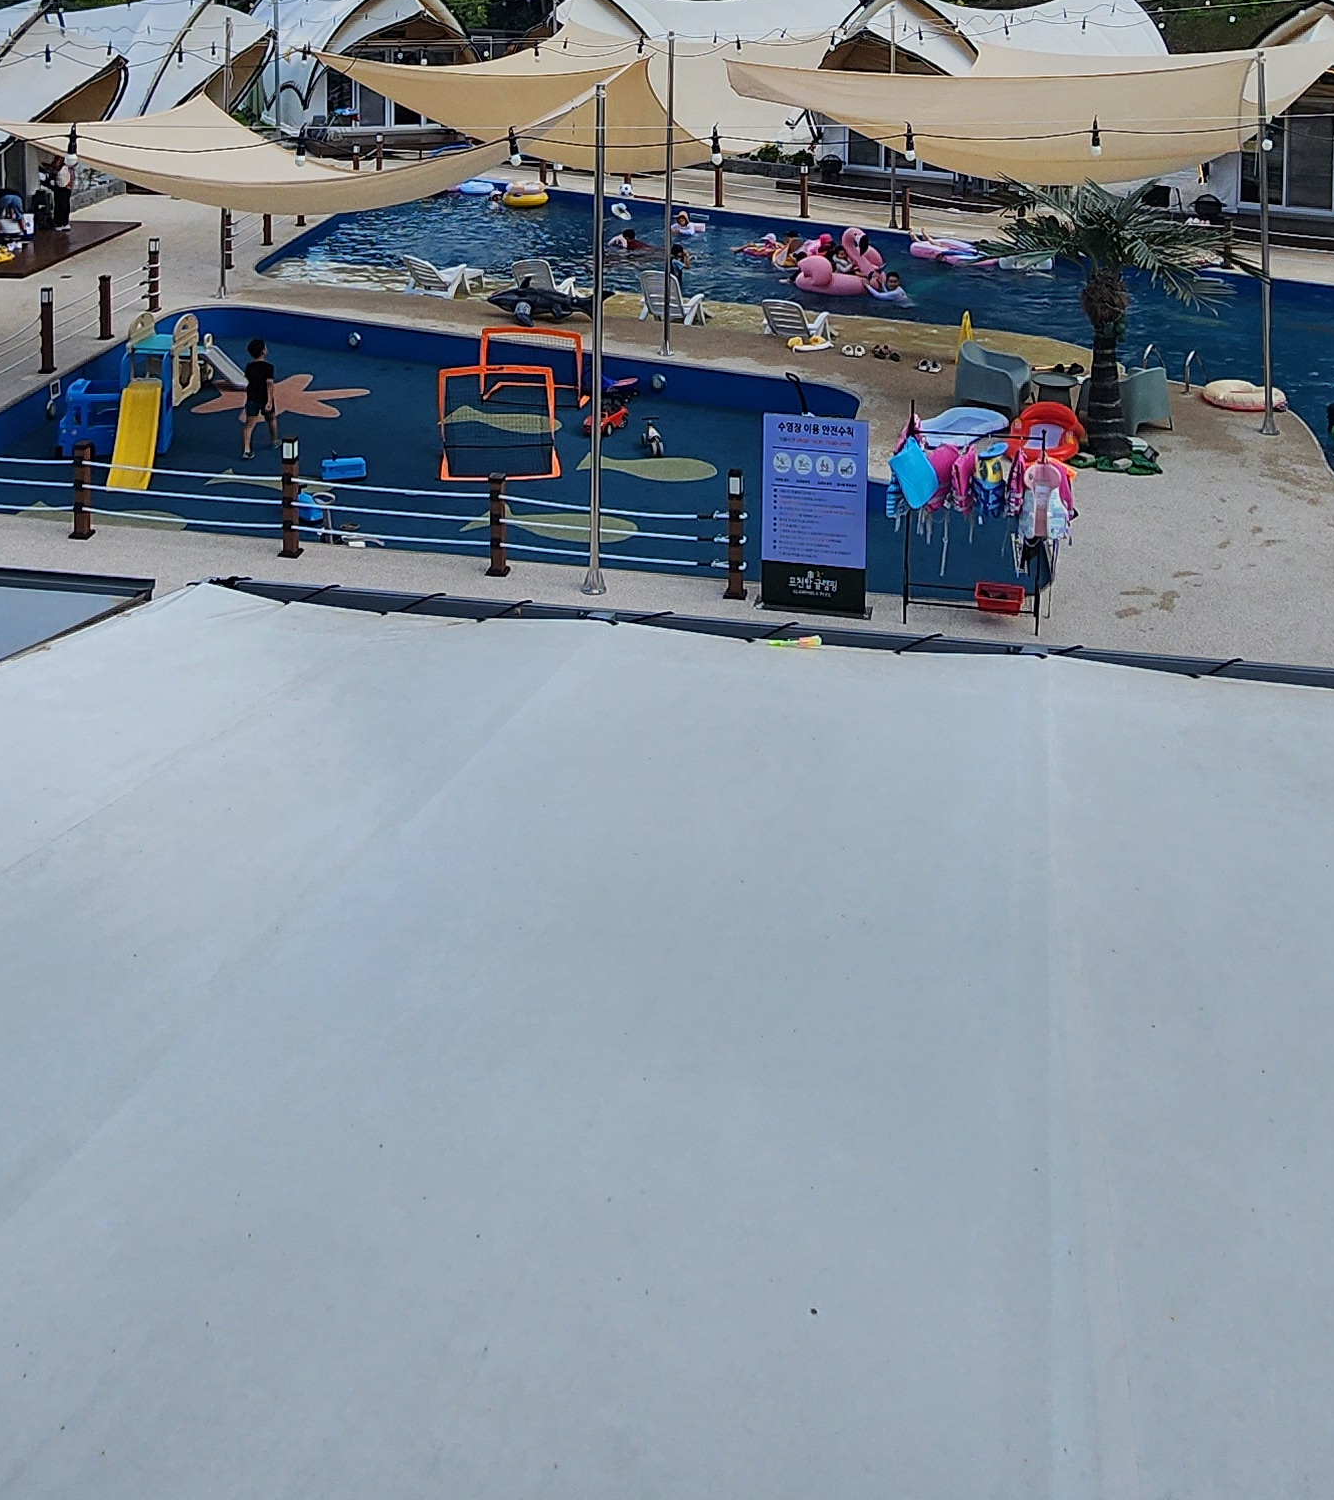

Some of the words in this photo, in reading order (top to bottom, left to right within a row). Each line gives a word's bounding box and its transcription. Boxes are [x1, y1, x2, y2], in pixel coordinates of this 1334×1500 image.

[778, 421, 802, 434] 수영장
[804, 423, 820, 435] 이용
[822, 425, 854, 438] 안전수칙
